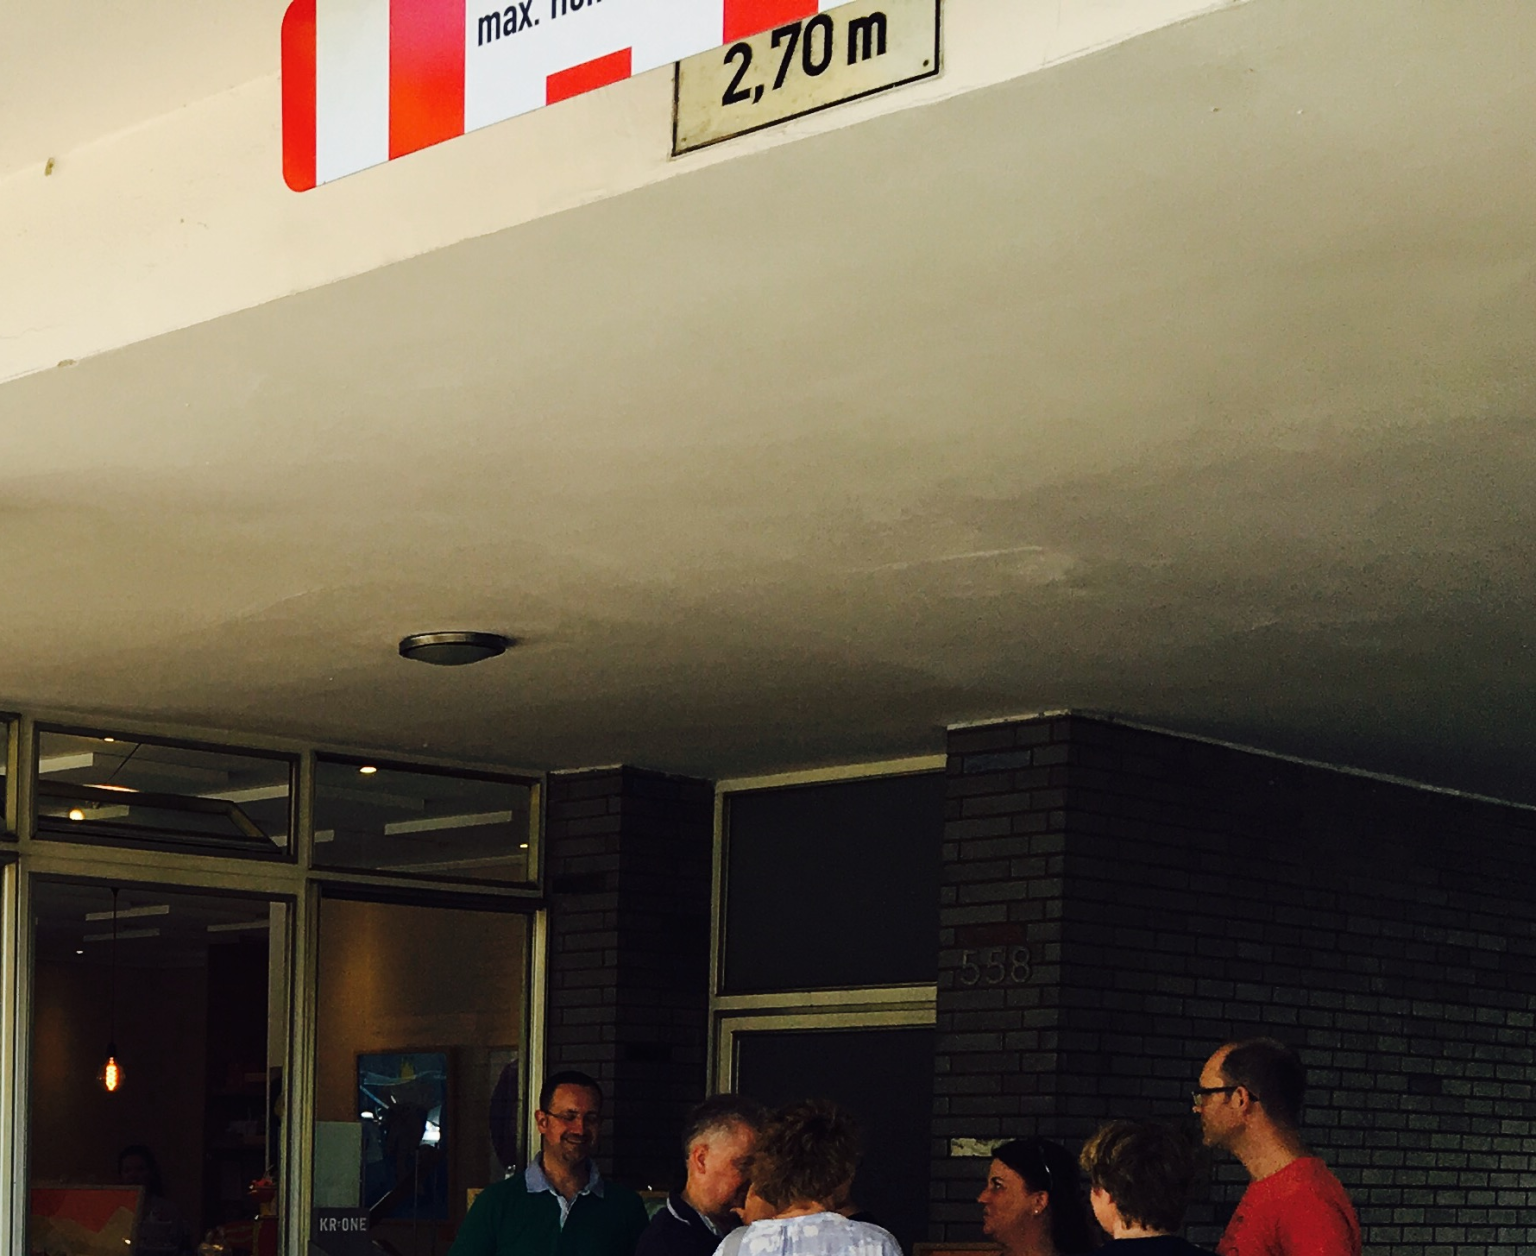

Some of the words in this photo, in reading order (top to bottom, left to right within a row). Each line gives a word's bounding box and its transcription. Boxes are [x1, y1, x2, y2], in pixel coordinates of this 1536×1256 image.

[477, 0, 540, 47] max.
[721, 13, 834, 107] 2,70
[845, 10, 889, 66] m
[961, 946, 1033, 985] 558
